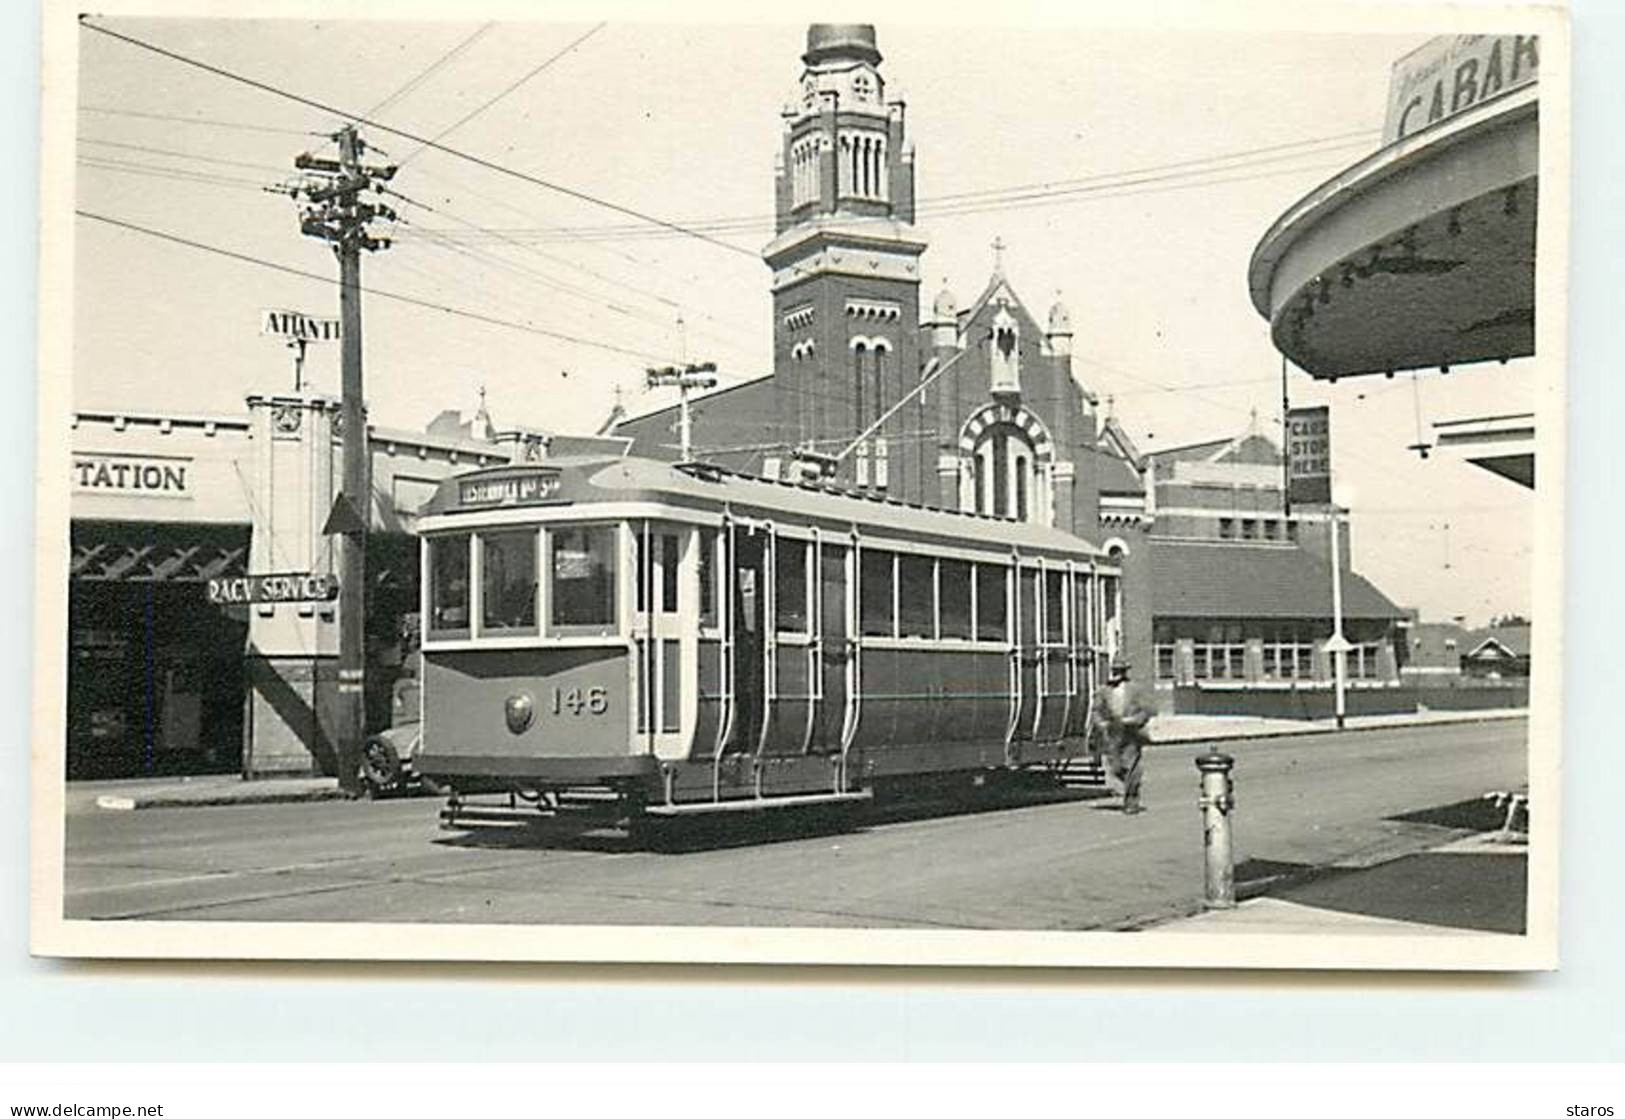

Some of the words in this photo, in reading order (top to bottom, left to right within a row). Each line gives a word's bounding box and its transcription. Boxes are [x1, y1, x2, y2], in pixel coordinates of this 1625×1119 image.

[75, 461, 186, 491] TATION
[260, 574, 328, 600] SERVICE
[551, 686, 609, 716] 146
